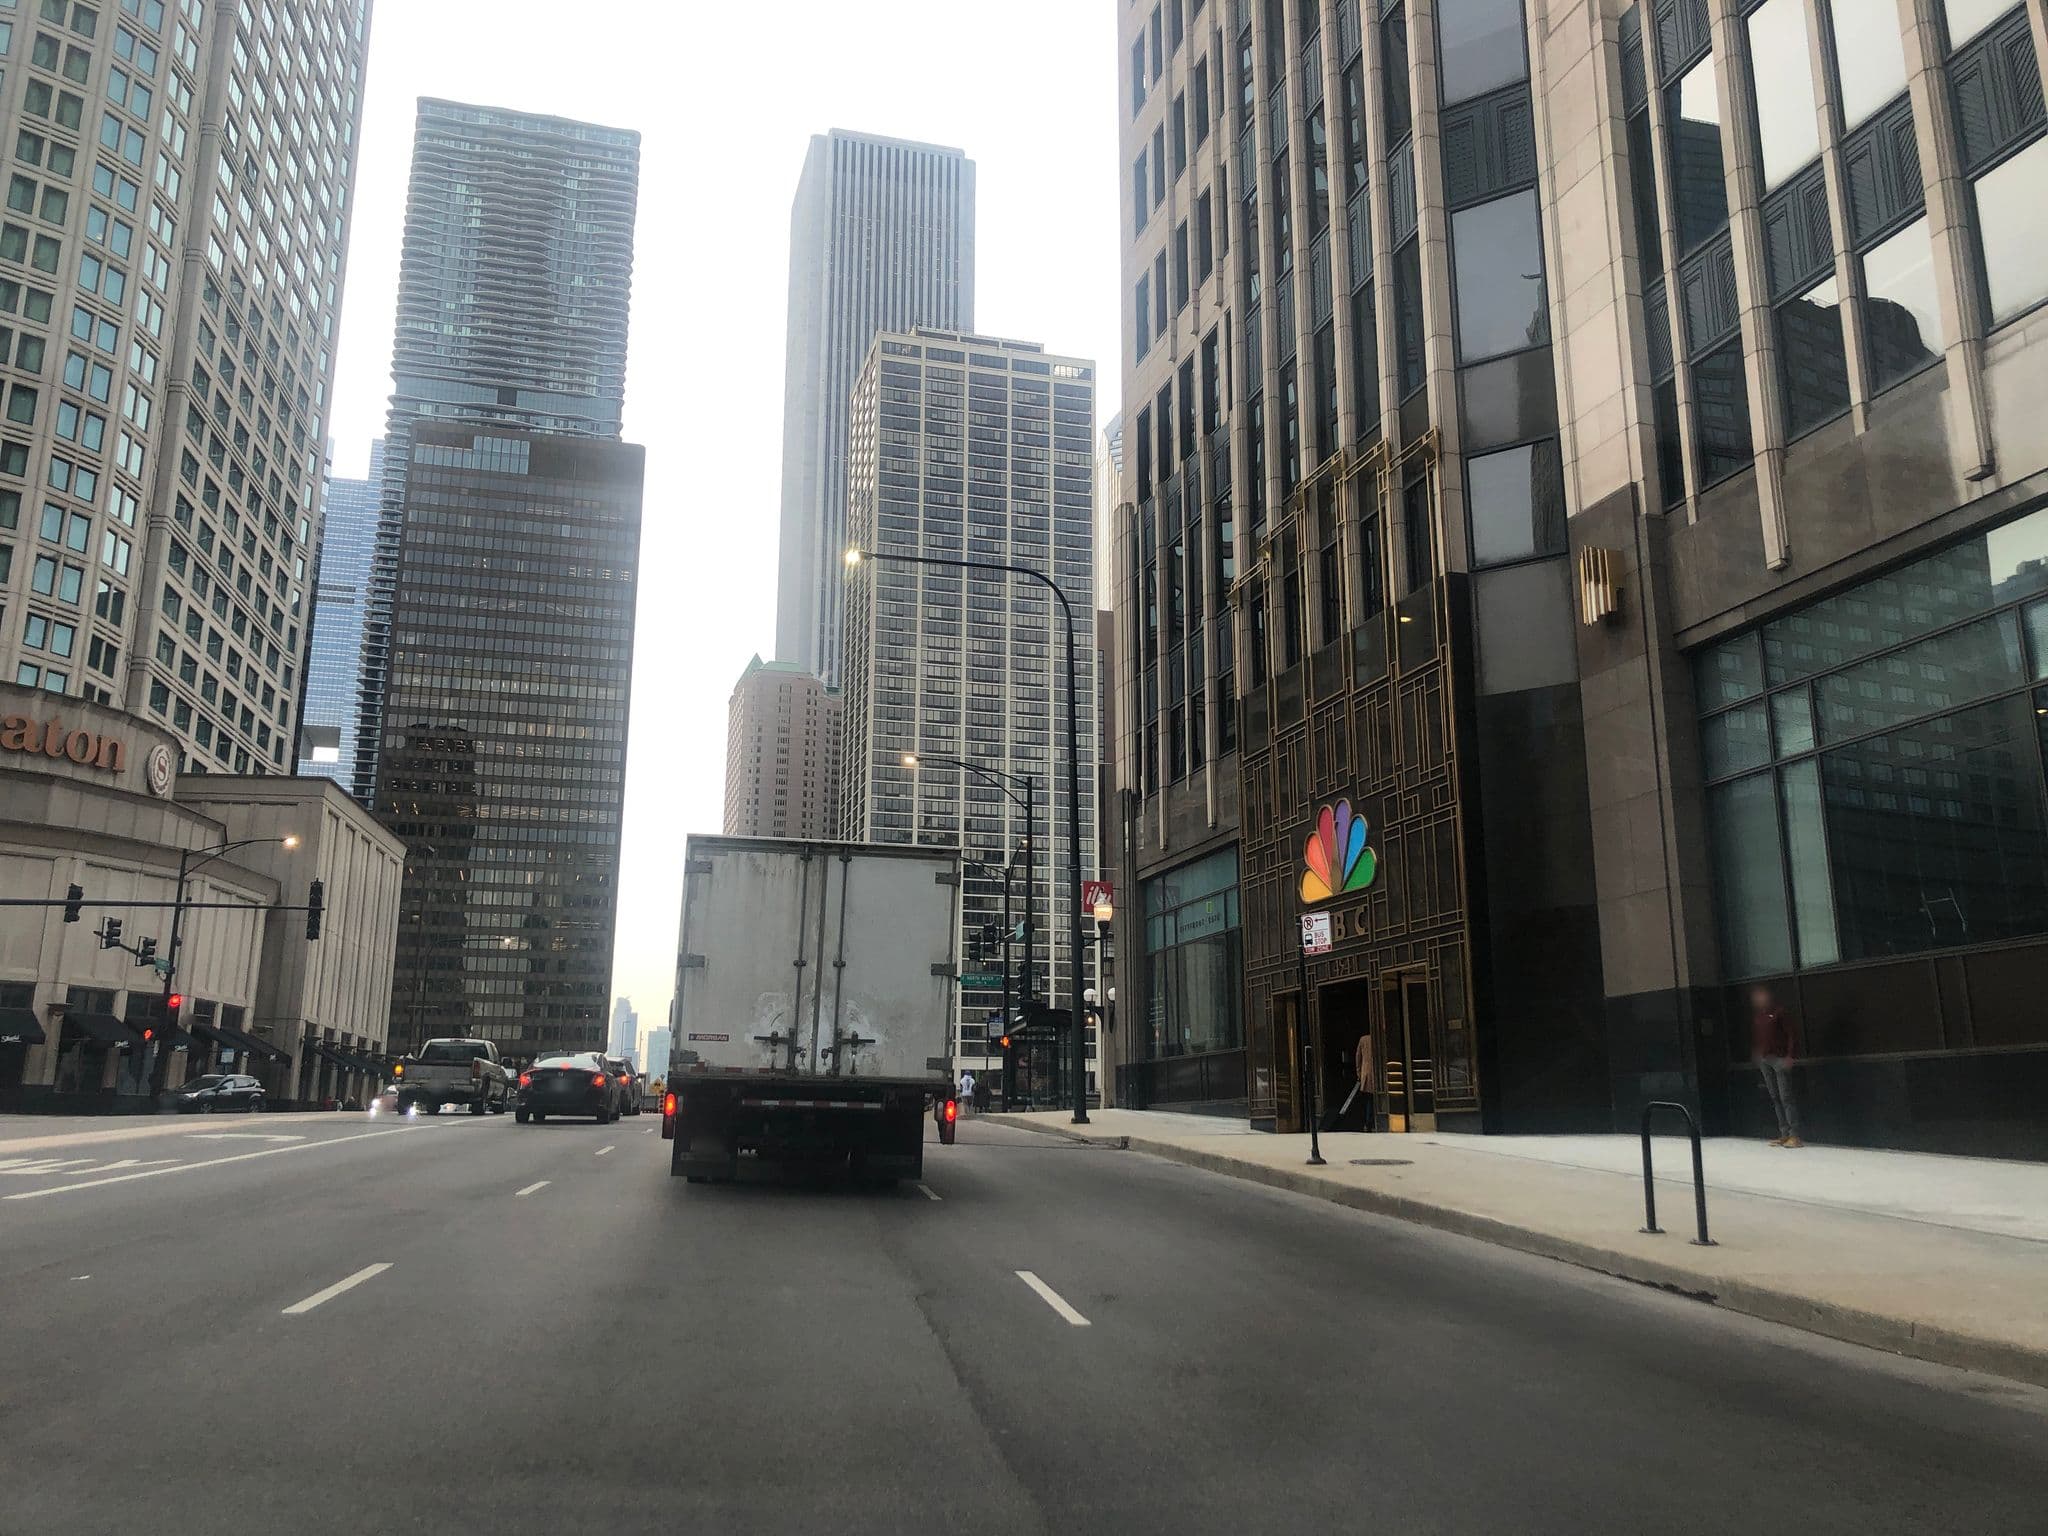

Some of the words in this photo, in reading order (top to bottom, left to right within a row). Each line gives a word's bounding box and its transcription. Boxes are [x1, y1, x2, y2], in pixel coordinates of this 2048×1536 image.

[1332, 906, 1366, 941] BC
[1314, 931, 1324, 939] BUS
[1314, 937, 1327, 945] STOP
